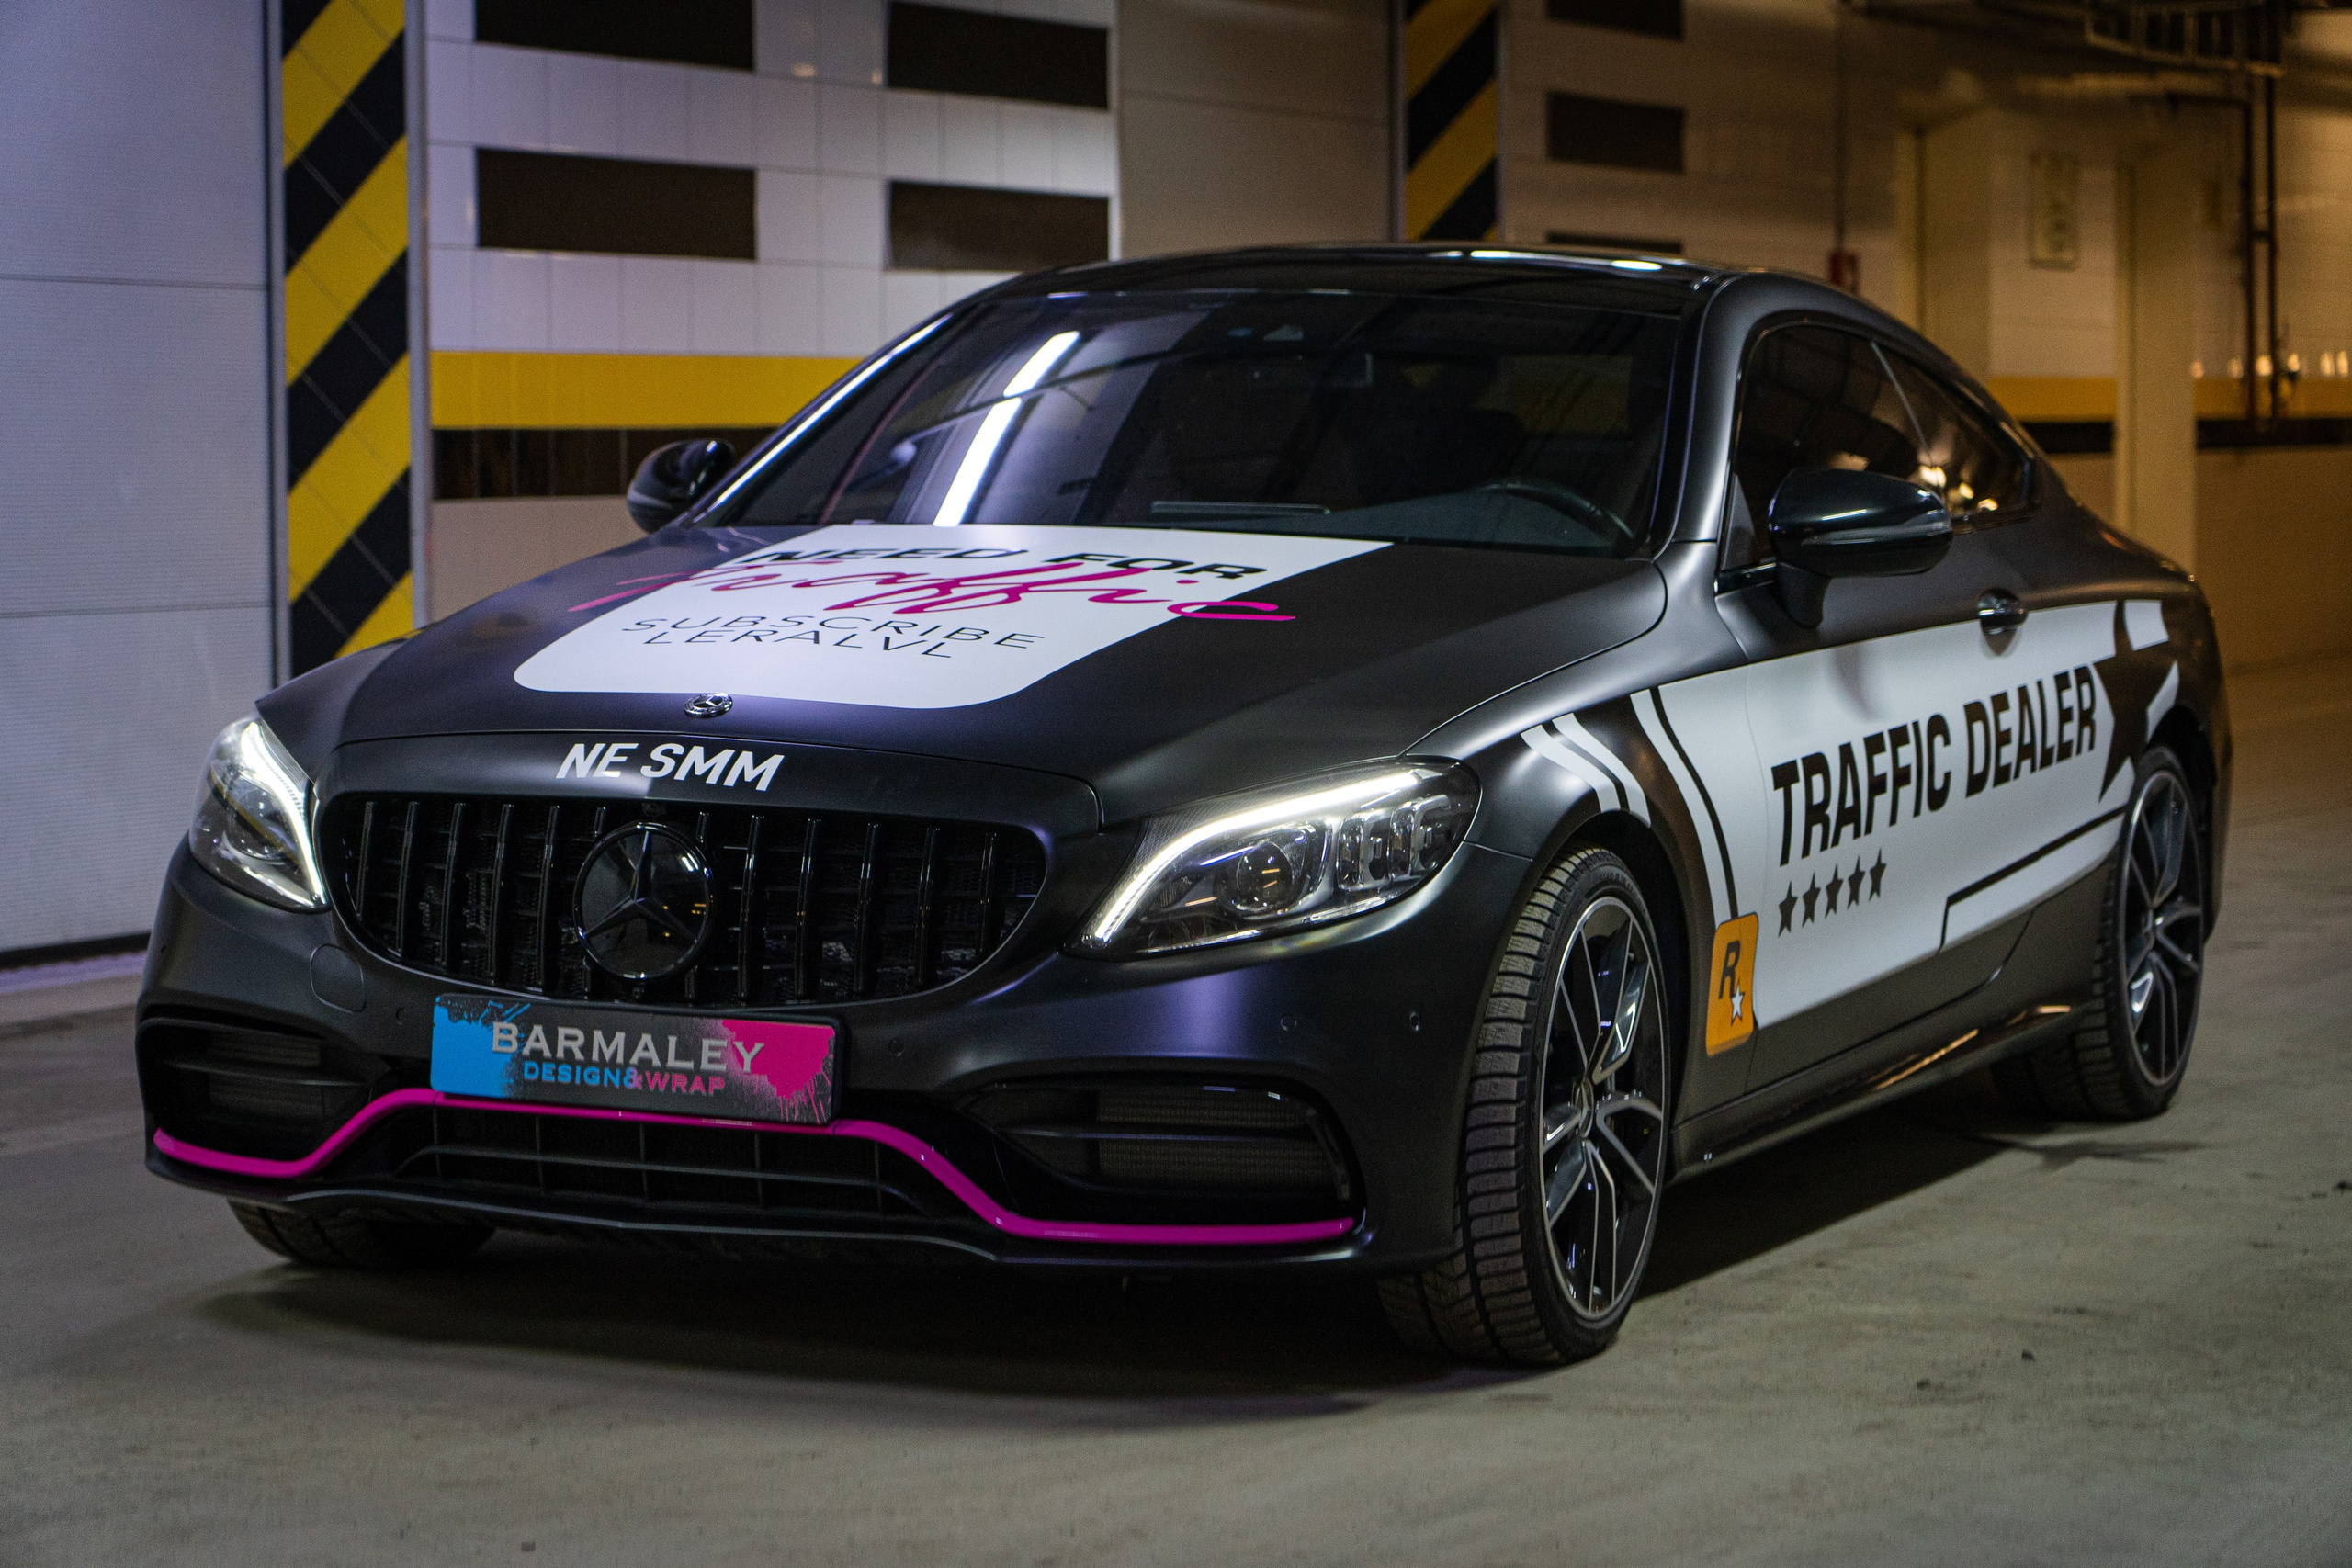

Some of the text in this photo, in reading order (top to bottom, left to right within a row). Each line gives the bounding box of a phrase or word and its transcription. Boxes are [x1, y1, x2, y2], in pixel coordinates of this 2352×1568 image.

[737, 548, 1268, 580] NEED FOR
[622, 615, 1046, 649] SUBSCRIBE
[643, 629, 952, 659] LERALVL
[555, 742, 785, 792] NE SMM
[1770, 664, 2097, 867] TRAFFIC DEALER
[1718, 939, 1740, 1000] R
[492, 1021, 764, 1073] BARMALEY
